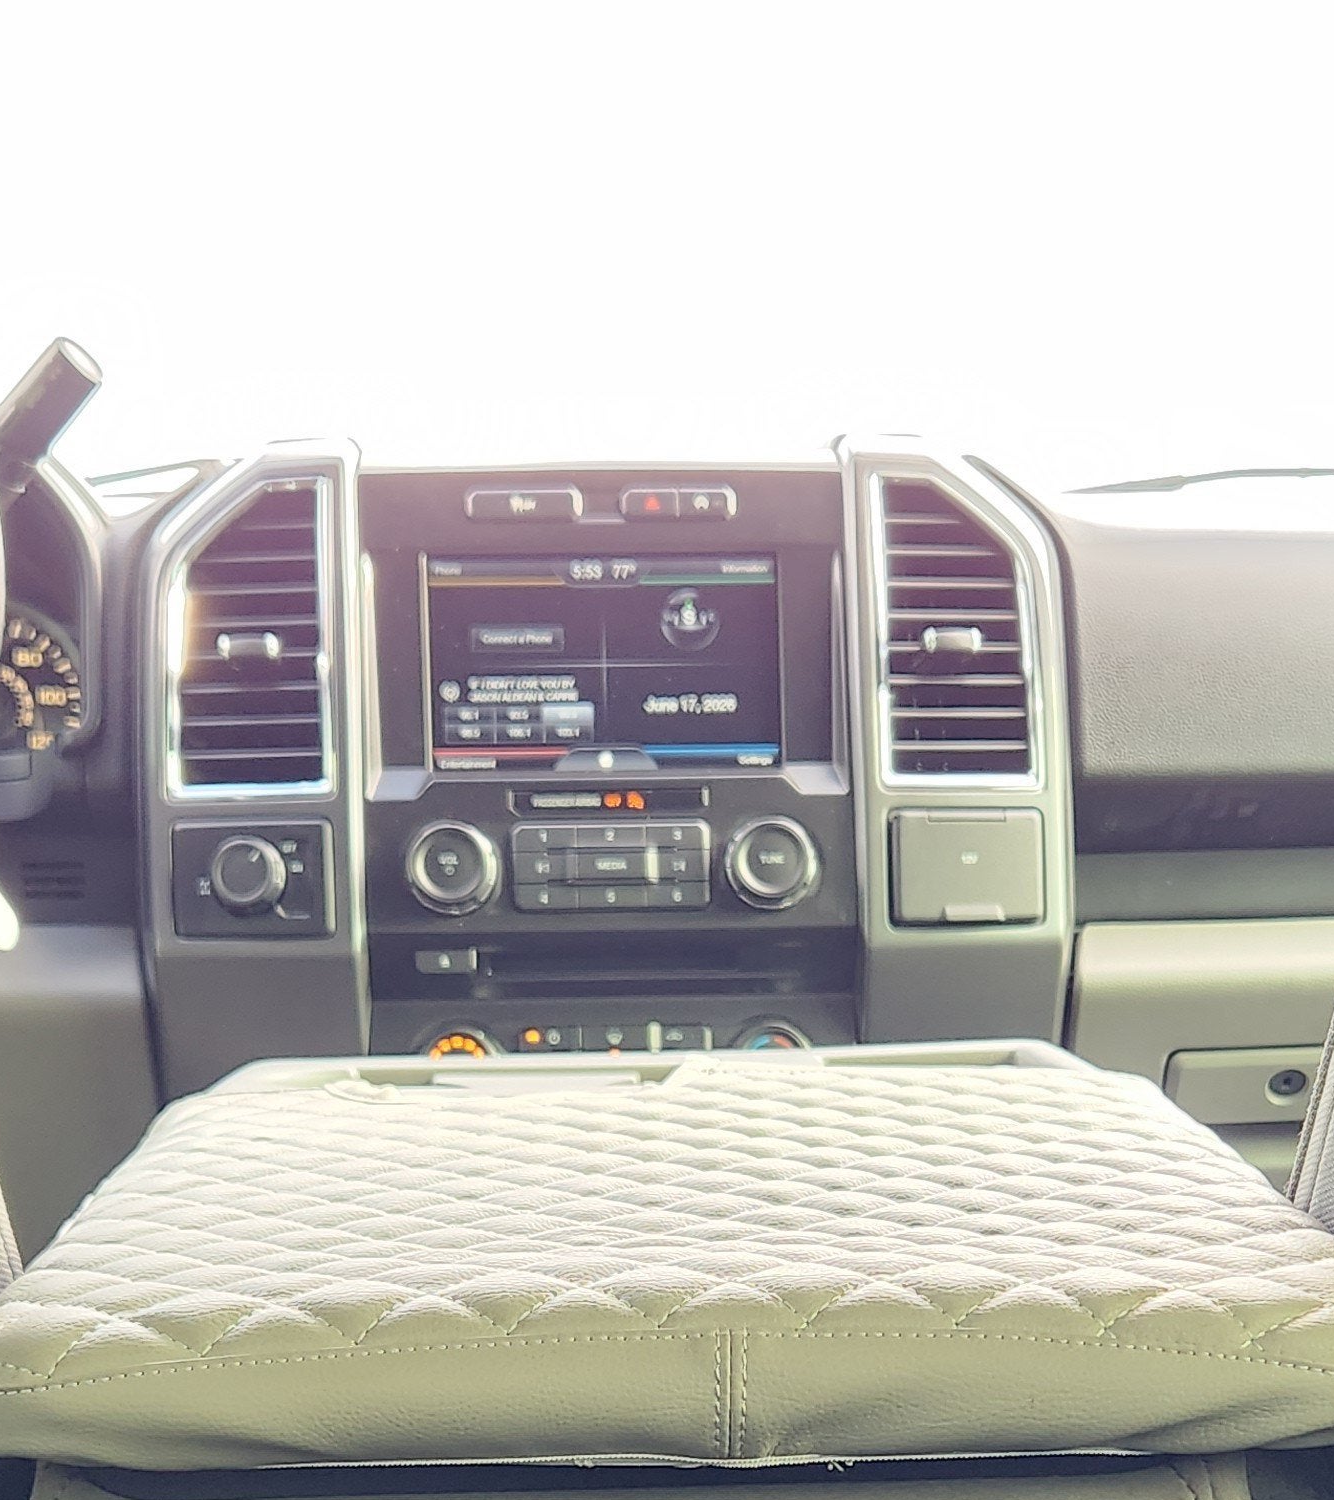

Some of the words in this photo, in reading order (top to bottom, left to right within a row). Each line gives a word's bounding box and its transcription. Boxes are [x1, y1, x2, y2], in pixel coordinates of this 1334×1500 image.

[37, 688, 67, 706] 100
[644, 697, 679, 713] June
[605, 829, 615, 842] 2
[673, 828, 682, 841] 3
[595, 859, 628, 872] MEDIA
[758, 853, 787, 865] TUNE
